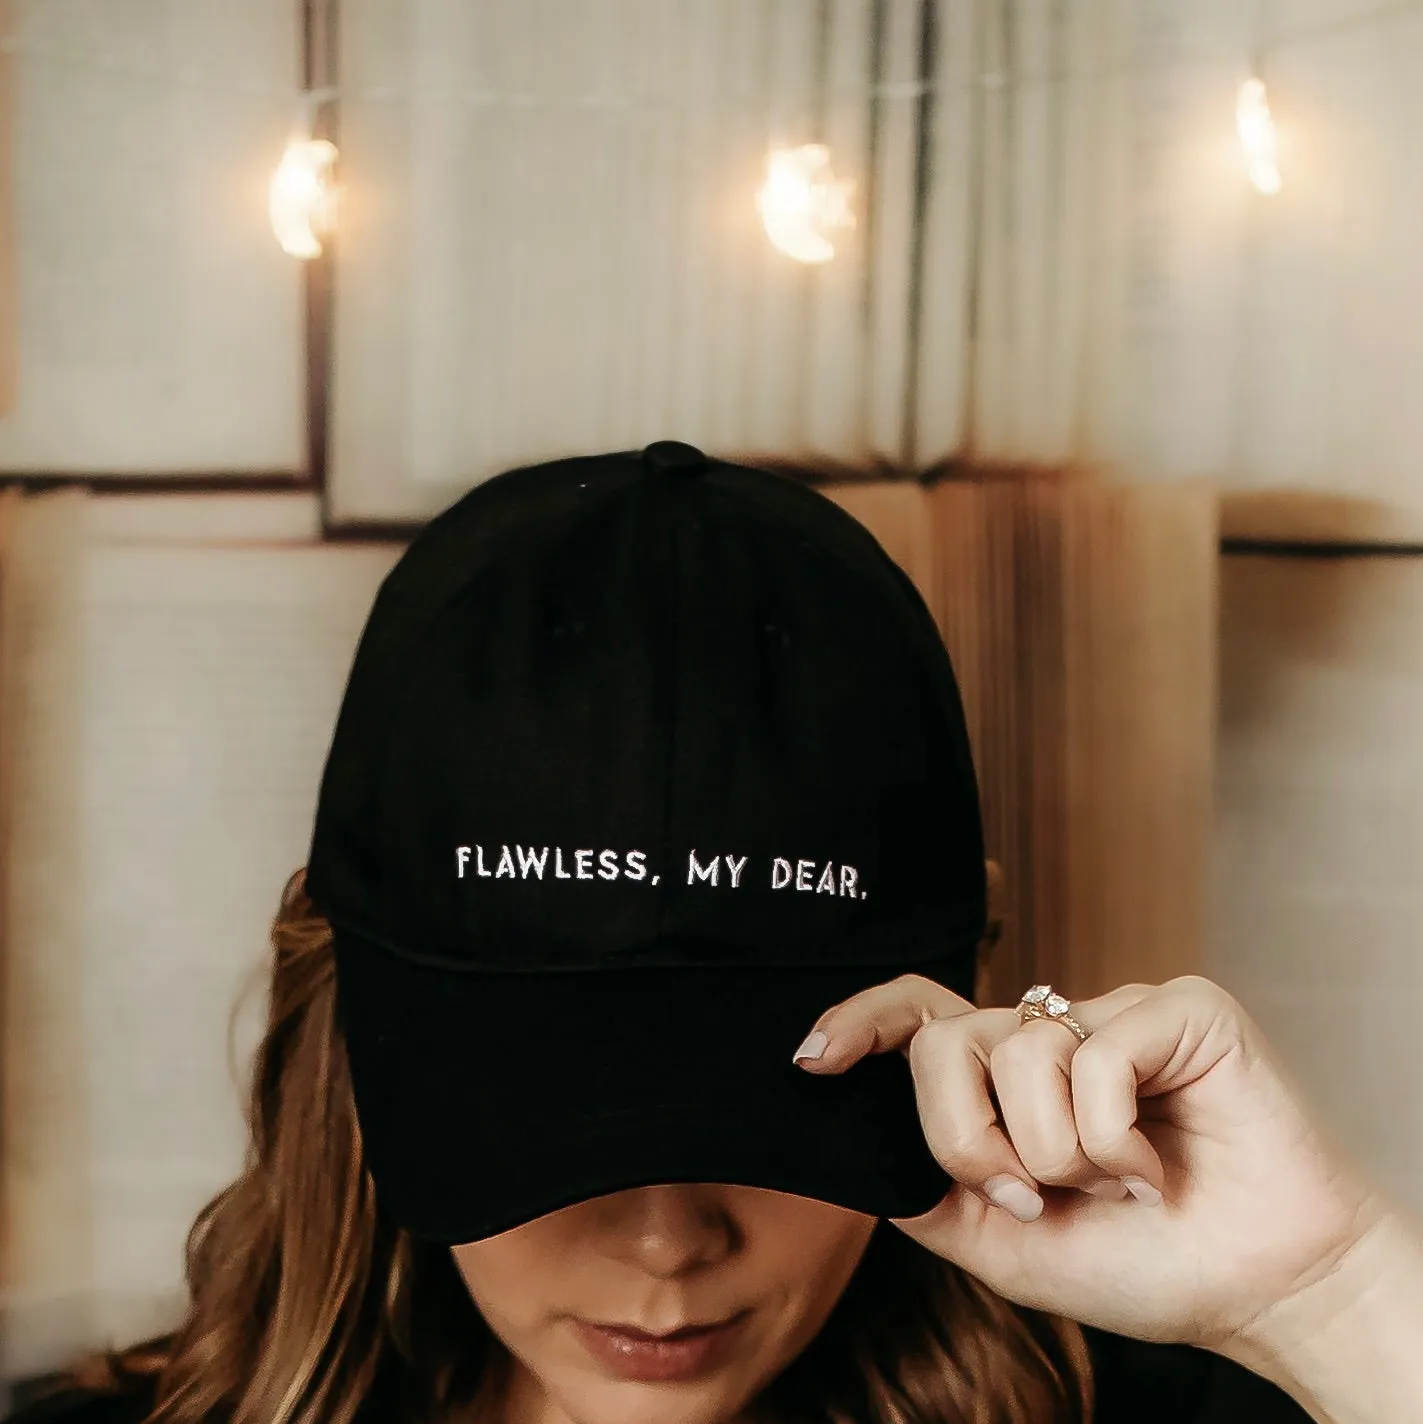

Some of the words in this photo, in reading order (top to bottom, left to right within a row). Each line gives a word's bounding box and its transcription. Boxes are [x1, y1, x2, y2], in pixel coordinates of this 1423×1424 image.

[455, 843, 661, 886] FLAWLESS,
[687, 848, 749, 888] MY
[771, 856, 868, 900] DEAR.
